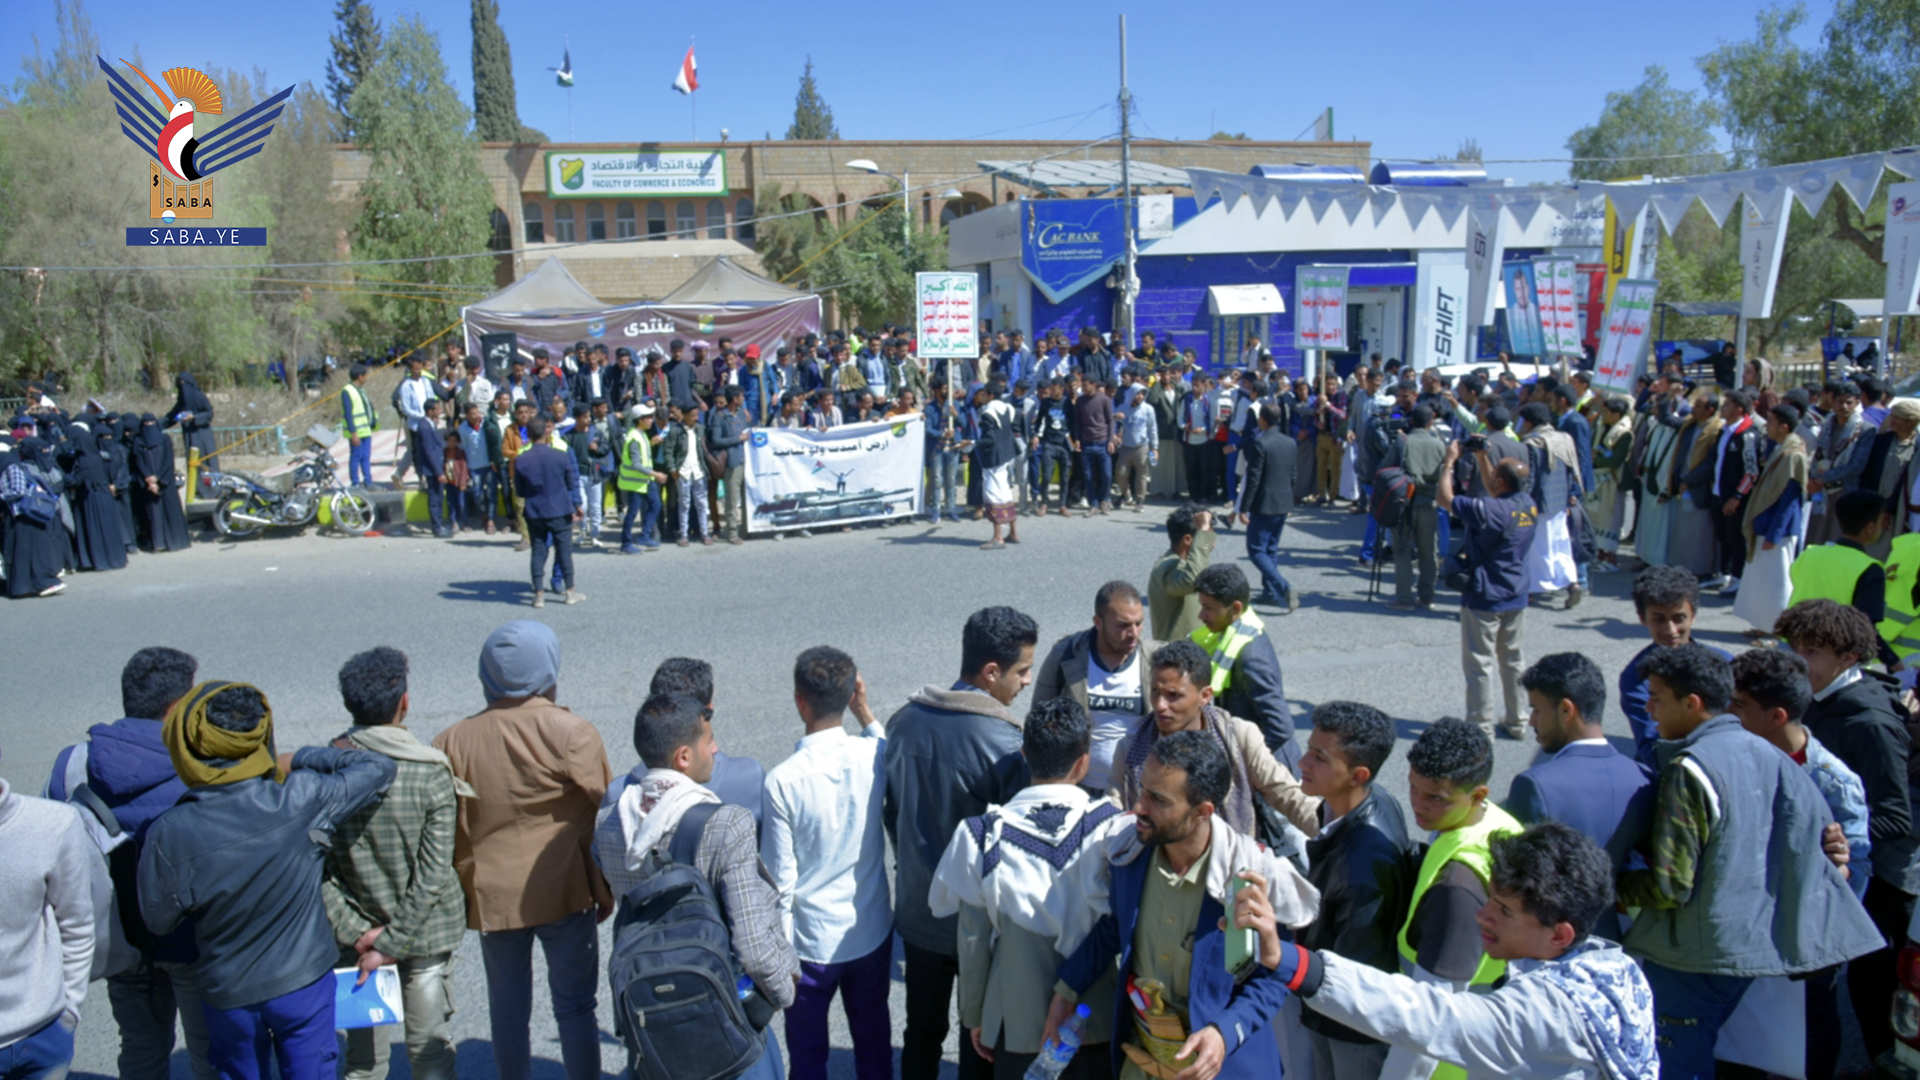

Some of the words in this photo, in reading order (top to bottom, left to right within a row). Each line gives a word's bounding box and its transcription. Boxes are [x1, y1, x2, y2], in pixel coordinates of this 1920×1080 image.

[590, 159, 643, 173] والاقتصاد
[646, 158, 684, 172] التجارة
[686, 158, 713, 171] كلية
[592, 179, 621, 189] FACULTY
[624, 179, 631, 188] OF
[633, 178, 670, 188] COMMERCE
[678, 178, 716, 188] ECONOMICS
[1038, 223, 1067, 248] CAC
[1068, 231, 1101, 243] BANK
[1434, 285, 1455, 358] SHIFT
[865, 437, 889, 452] أرض
[1088, 695, 1135, 709] TATUS
